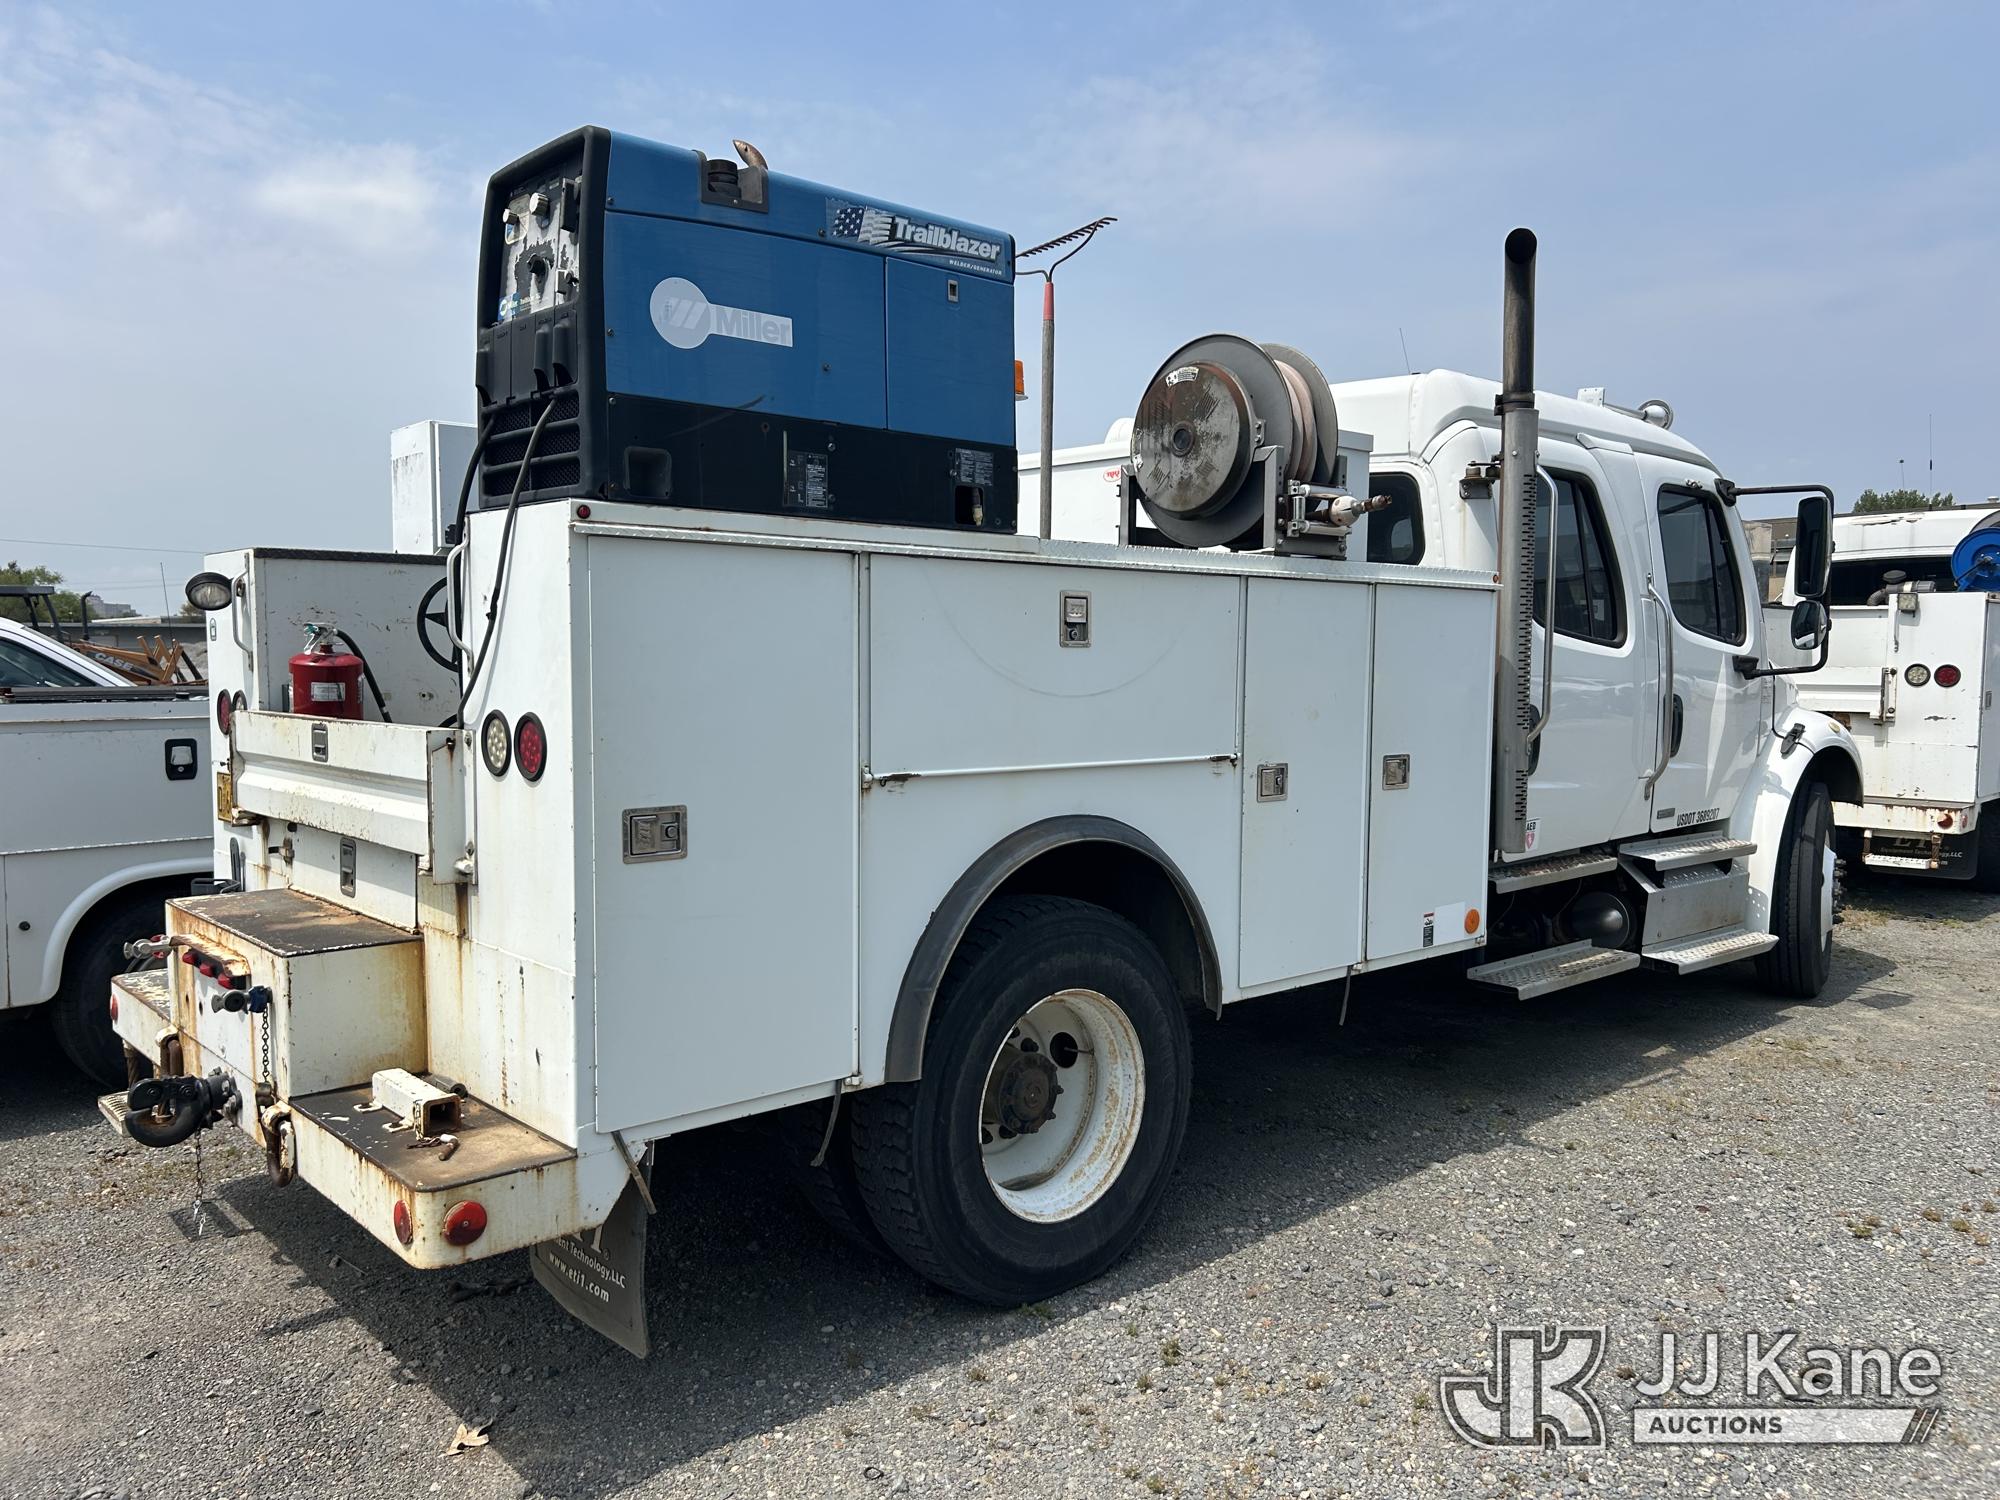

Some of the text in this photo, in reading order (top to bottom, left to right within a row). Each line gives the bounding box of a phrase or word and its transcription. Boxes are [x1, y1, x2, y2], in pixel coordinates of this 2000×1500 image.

[894, 215, 1000, 261] Trailblazer
[949, 258, 1003, 275] WELDER/GENERATOR
[714, 304, 793, 347] Miller
[95, 651, 133, 671] CASE
[1676, 811, 1696, 827] USDOT
[1695, 807, 1720, 824] 3689207
[549, 1252, 610, 1302] www.eti1.com
